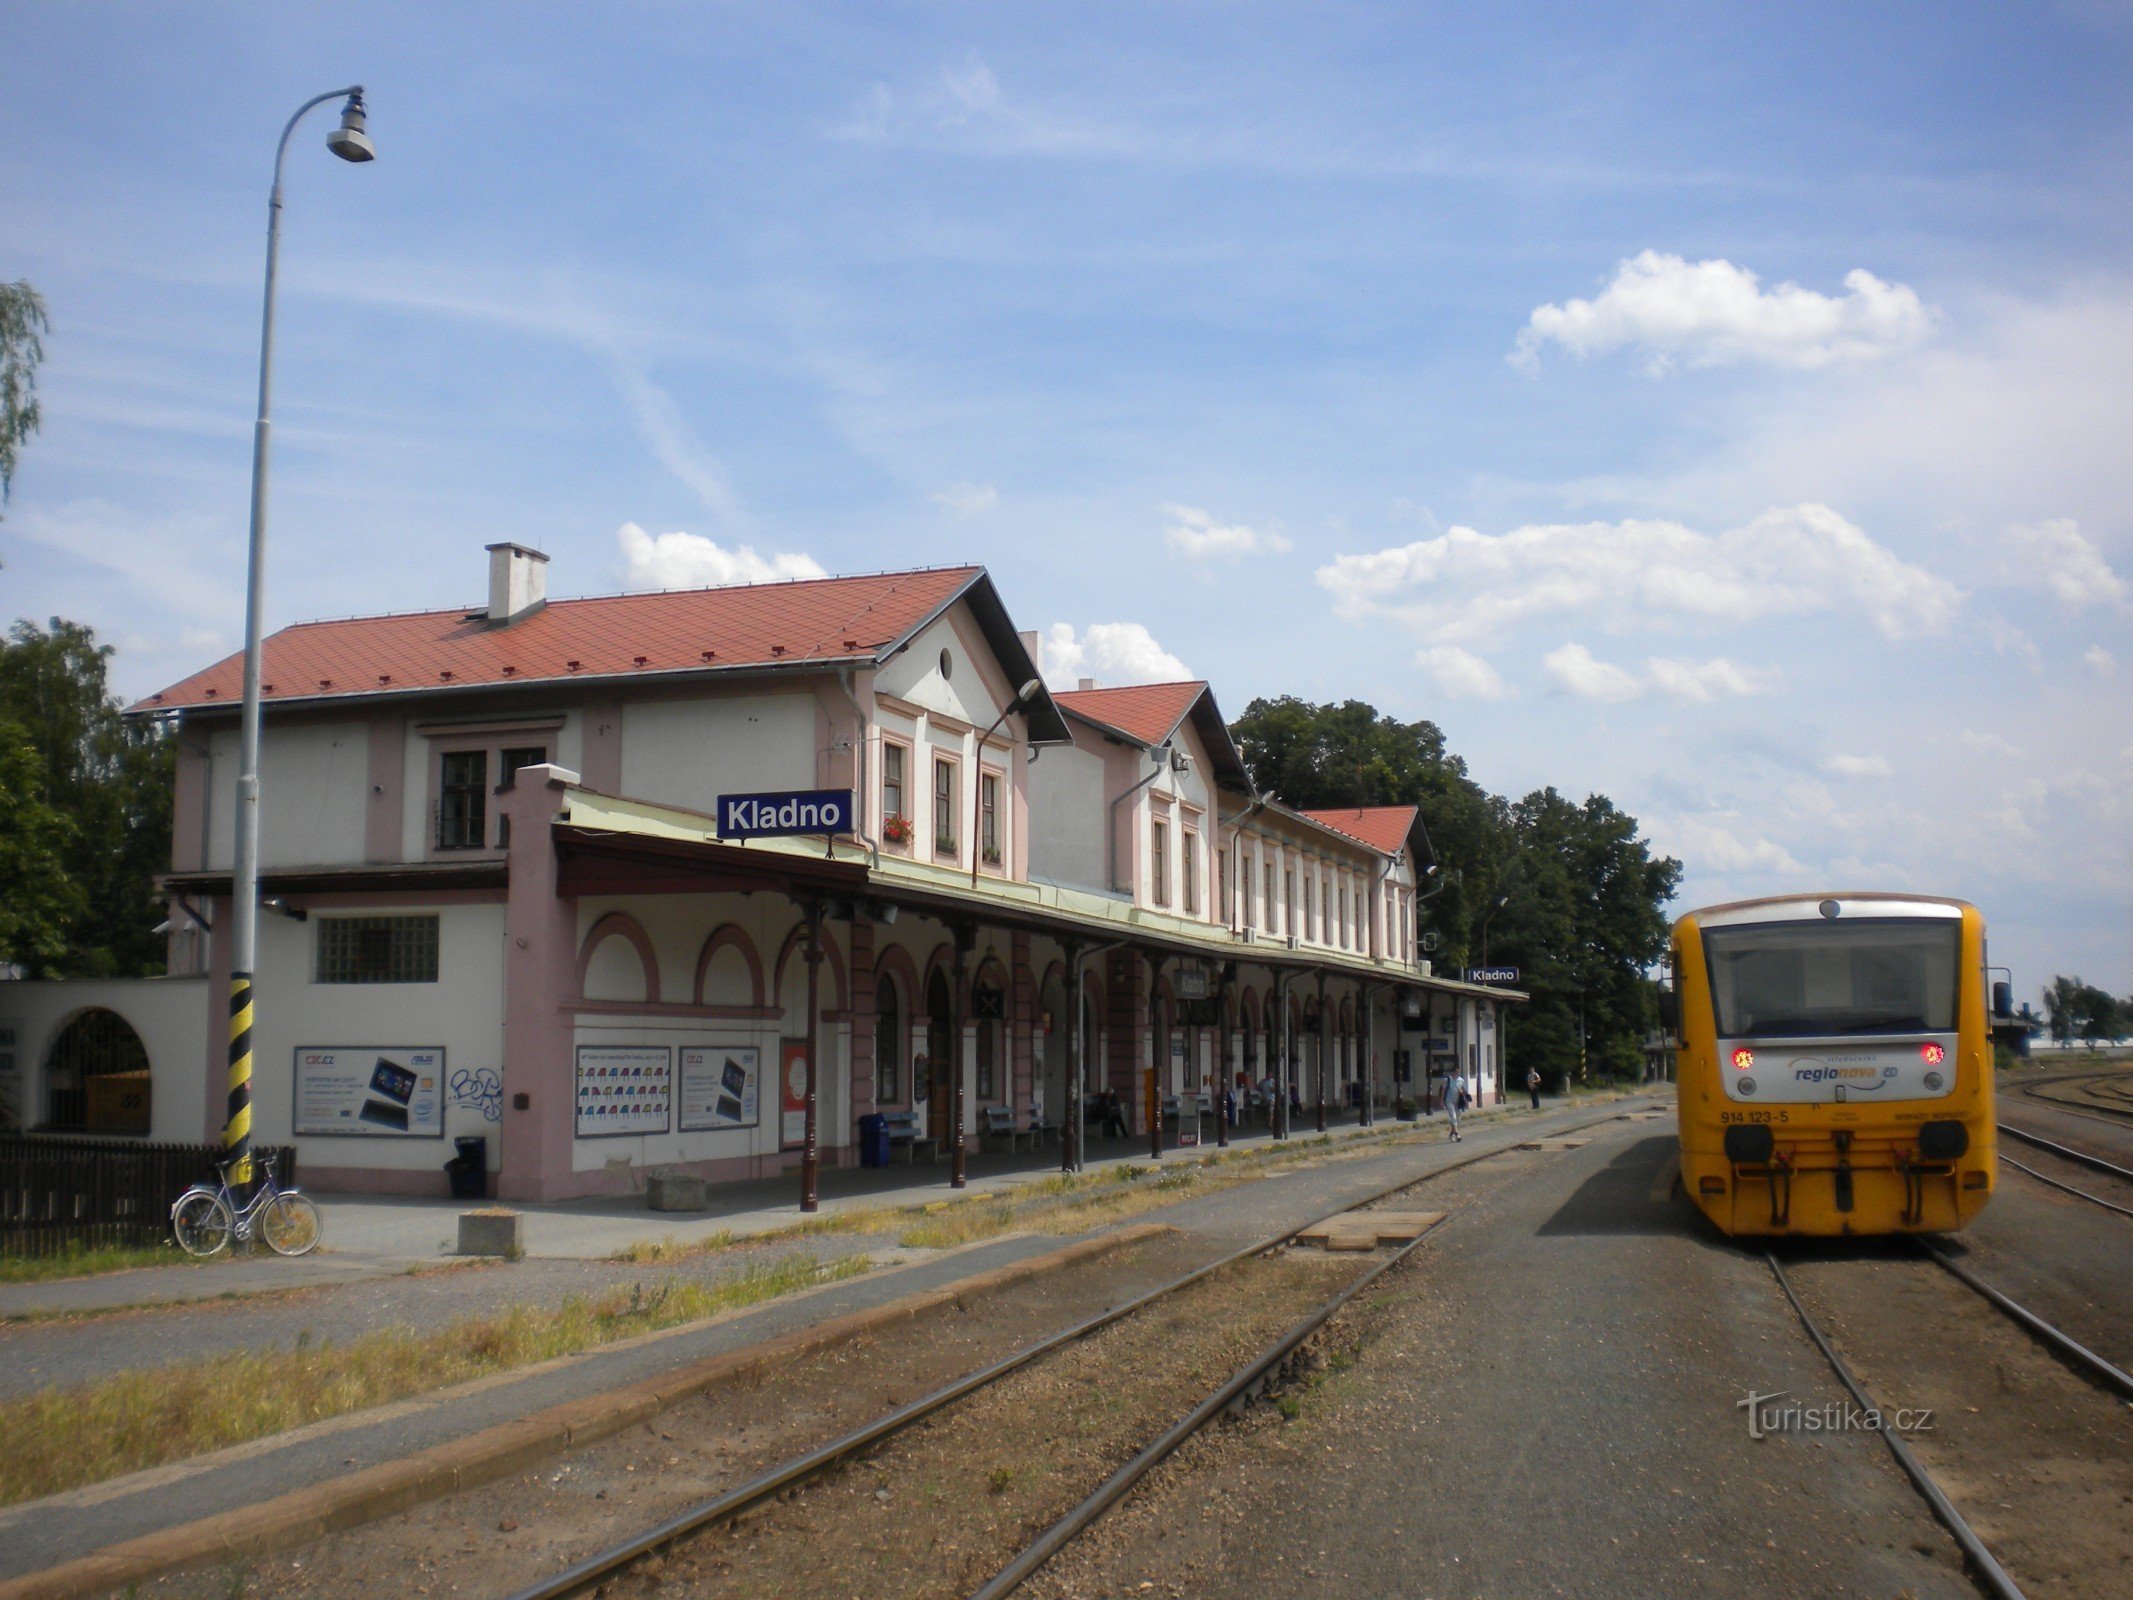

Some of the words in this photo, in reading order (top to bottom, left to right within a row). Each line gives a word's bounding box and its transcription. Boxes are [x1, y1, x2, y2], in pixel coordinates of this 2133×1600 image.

[728, 799, 840, 831] Kladno
[1473, 970, 1514, 981] Kladno
[1795, 1066, 1877, 1083] regionova
[1721, 1111, 1744, 1124] 914
